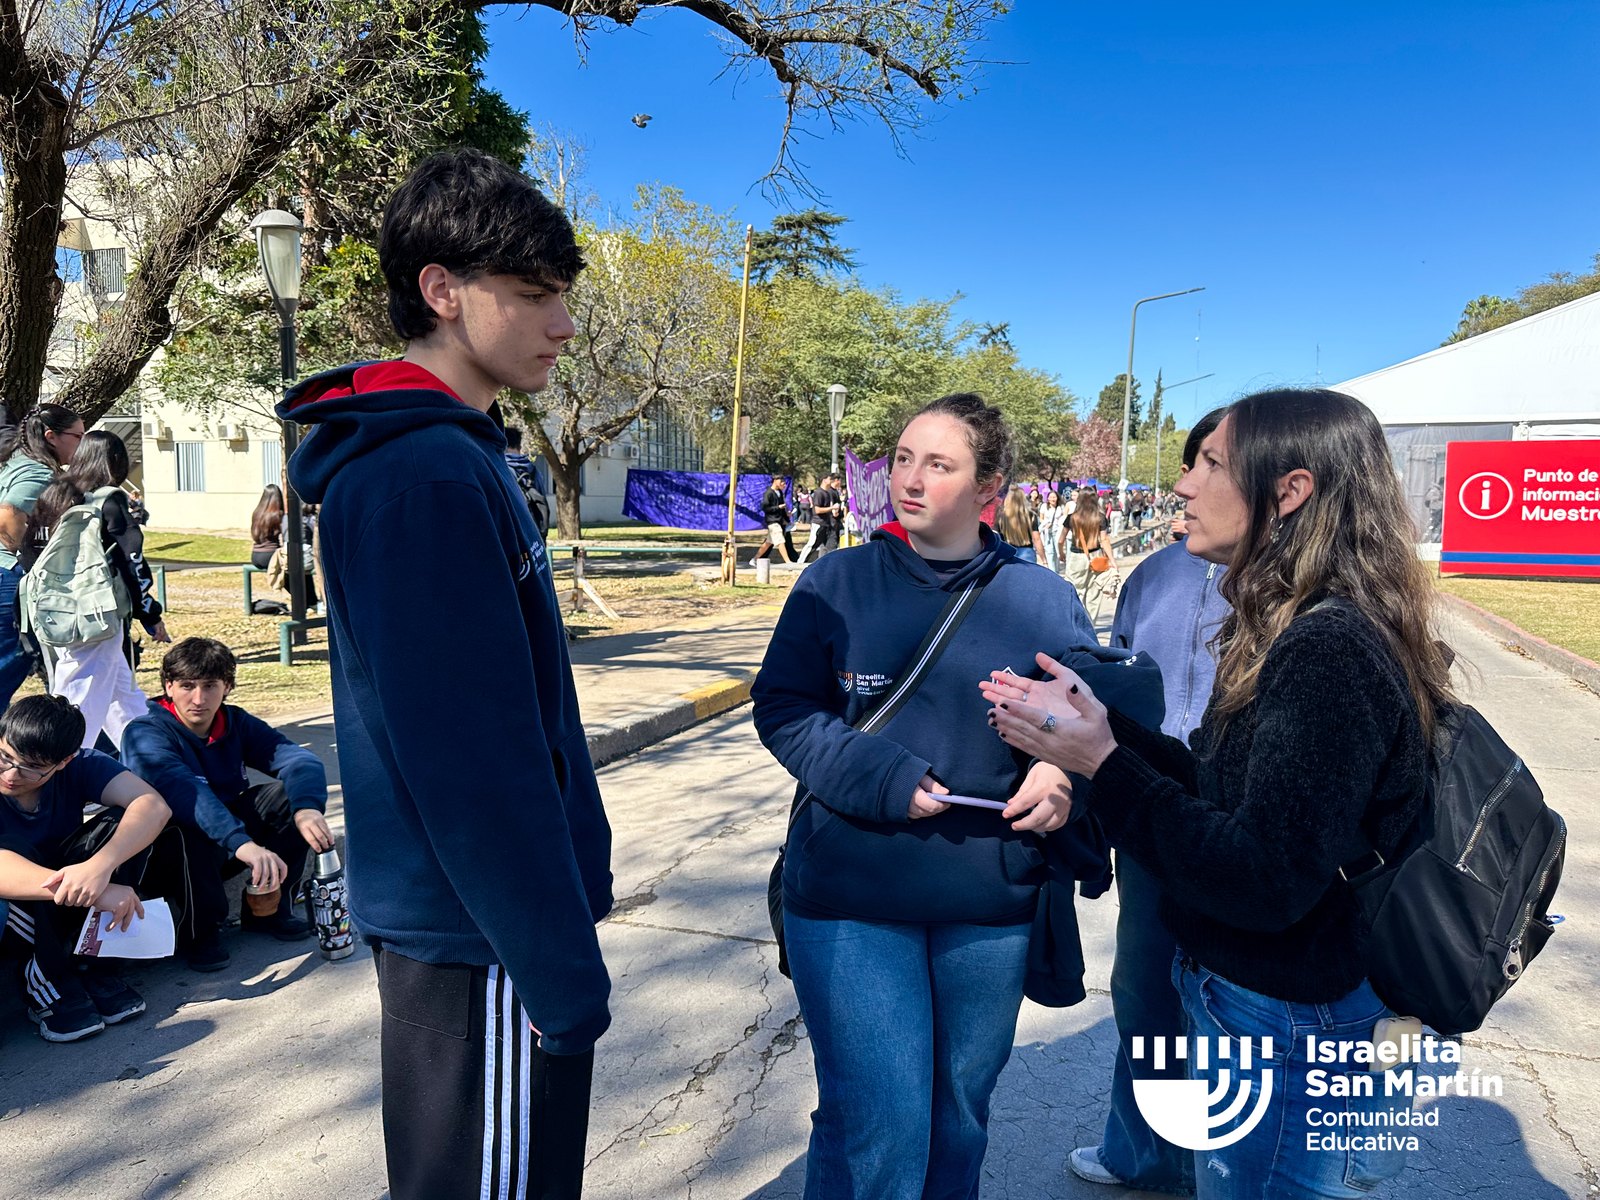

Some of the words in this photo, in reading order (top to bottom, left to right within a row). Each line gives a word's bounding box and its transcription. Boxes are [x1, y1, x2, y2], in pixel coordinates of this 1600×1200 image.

[1523, 469, 1574, 482] Punto
[1578, 468, 1599, 482] de
[1522, 487, 1600, 501] informaci
